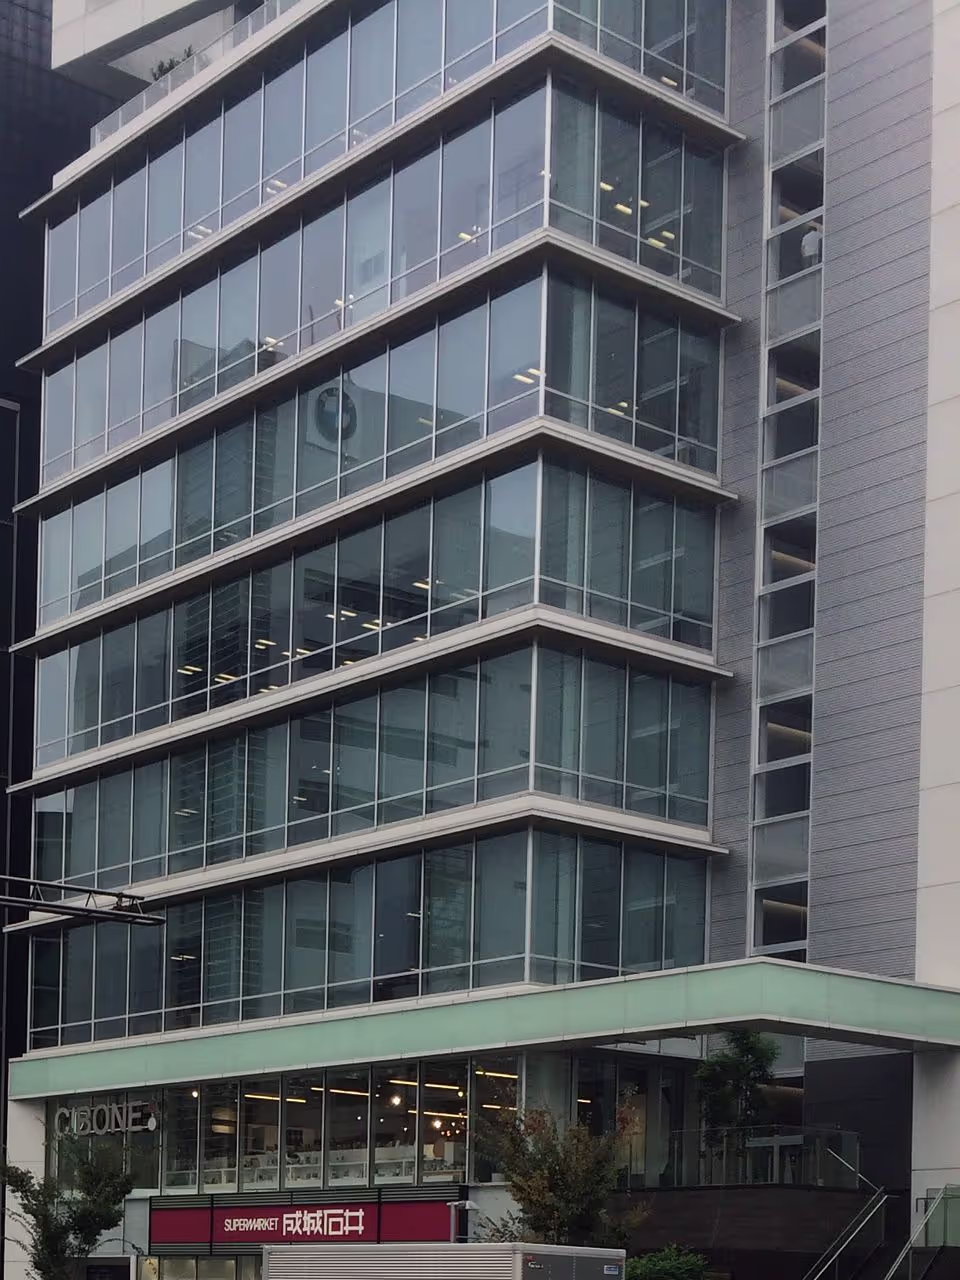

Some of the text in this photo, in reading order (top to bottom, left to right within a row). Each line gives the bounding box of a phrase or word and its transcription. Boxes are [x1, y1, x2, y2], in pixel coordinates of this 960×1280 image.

[54, 1100, 142, 1136] CIBONE
[224, 1208, 365, 1236] SUPERMARKET 成城石井
